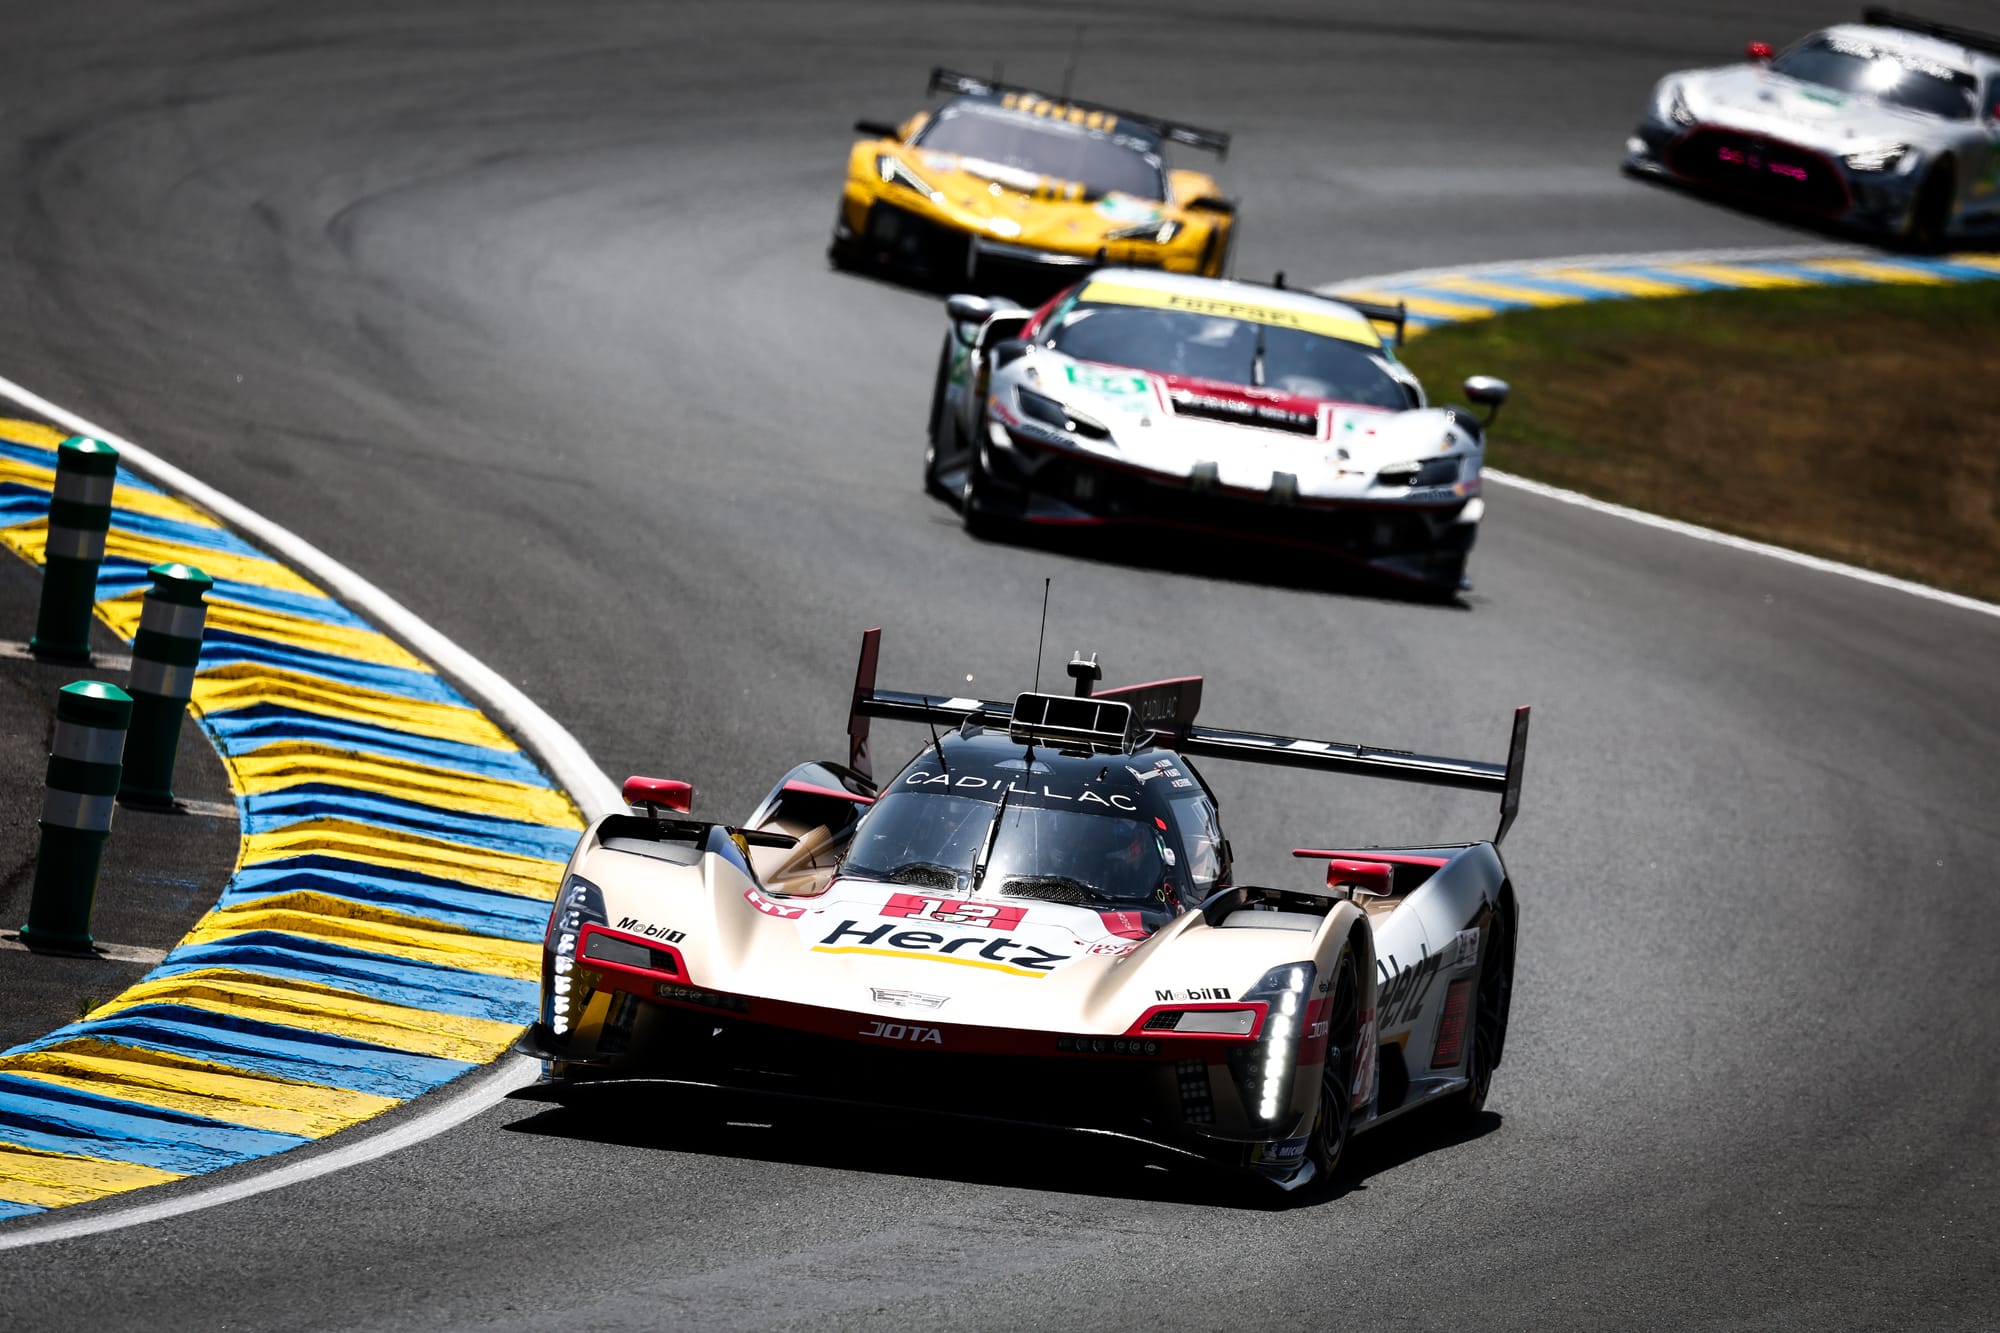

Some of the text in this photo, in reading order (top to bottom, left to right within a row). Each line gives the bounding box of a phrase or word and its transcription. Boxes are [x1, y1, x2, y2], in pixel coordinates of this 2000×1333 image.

[905, 771, 1137, 811] CADILLAC
[904, 898, 1002, 928] 12
[616, 916, 671, 939] Mobil
[819, 919, 1072, 970] Hertz
[1155, 988, 1213, 1001] Mobil
[858, 1021, 942, 1044] JOTA
